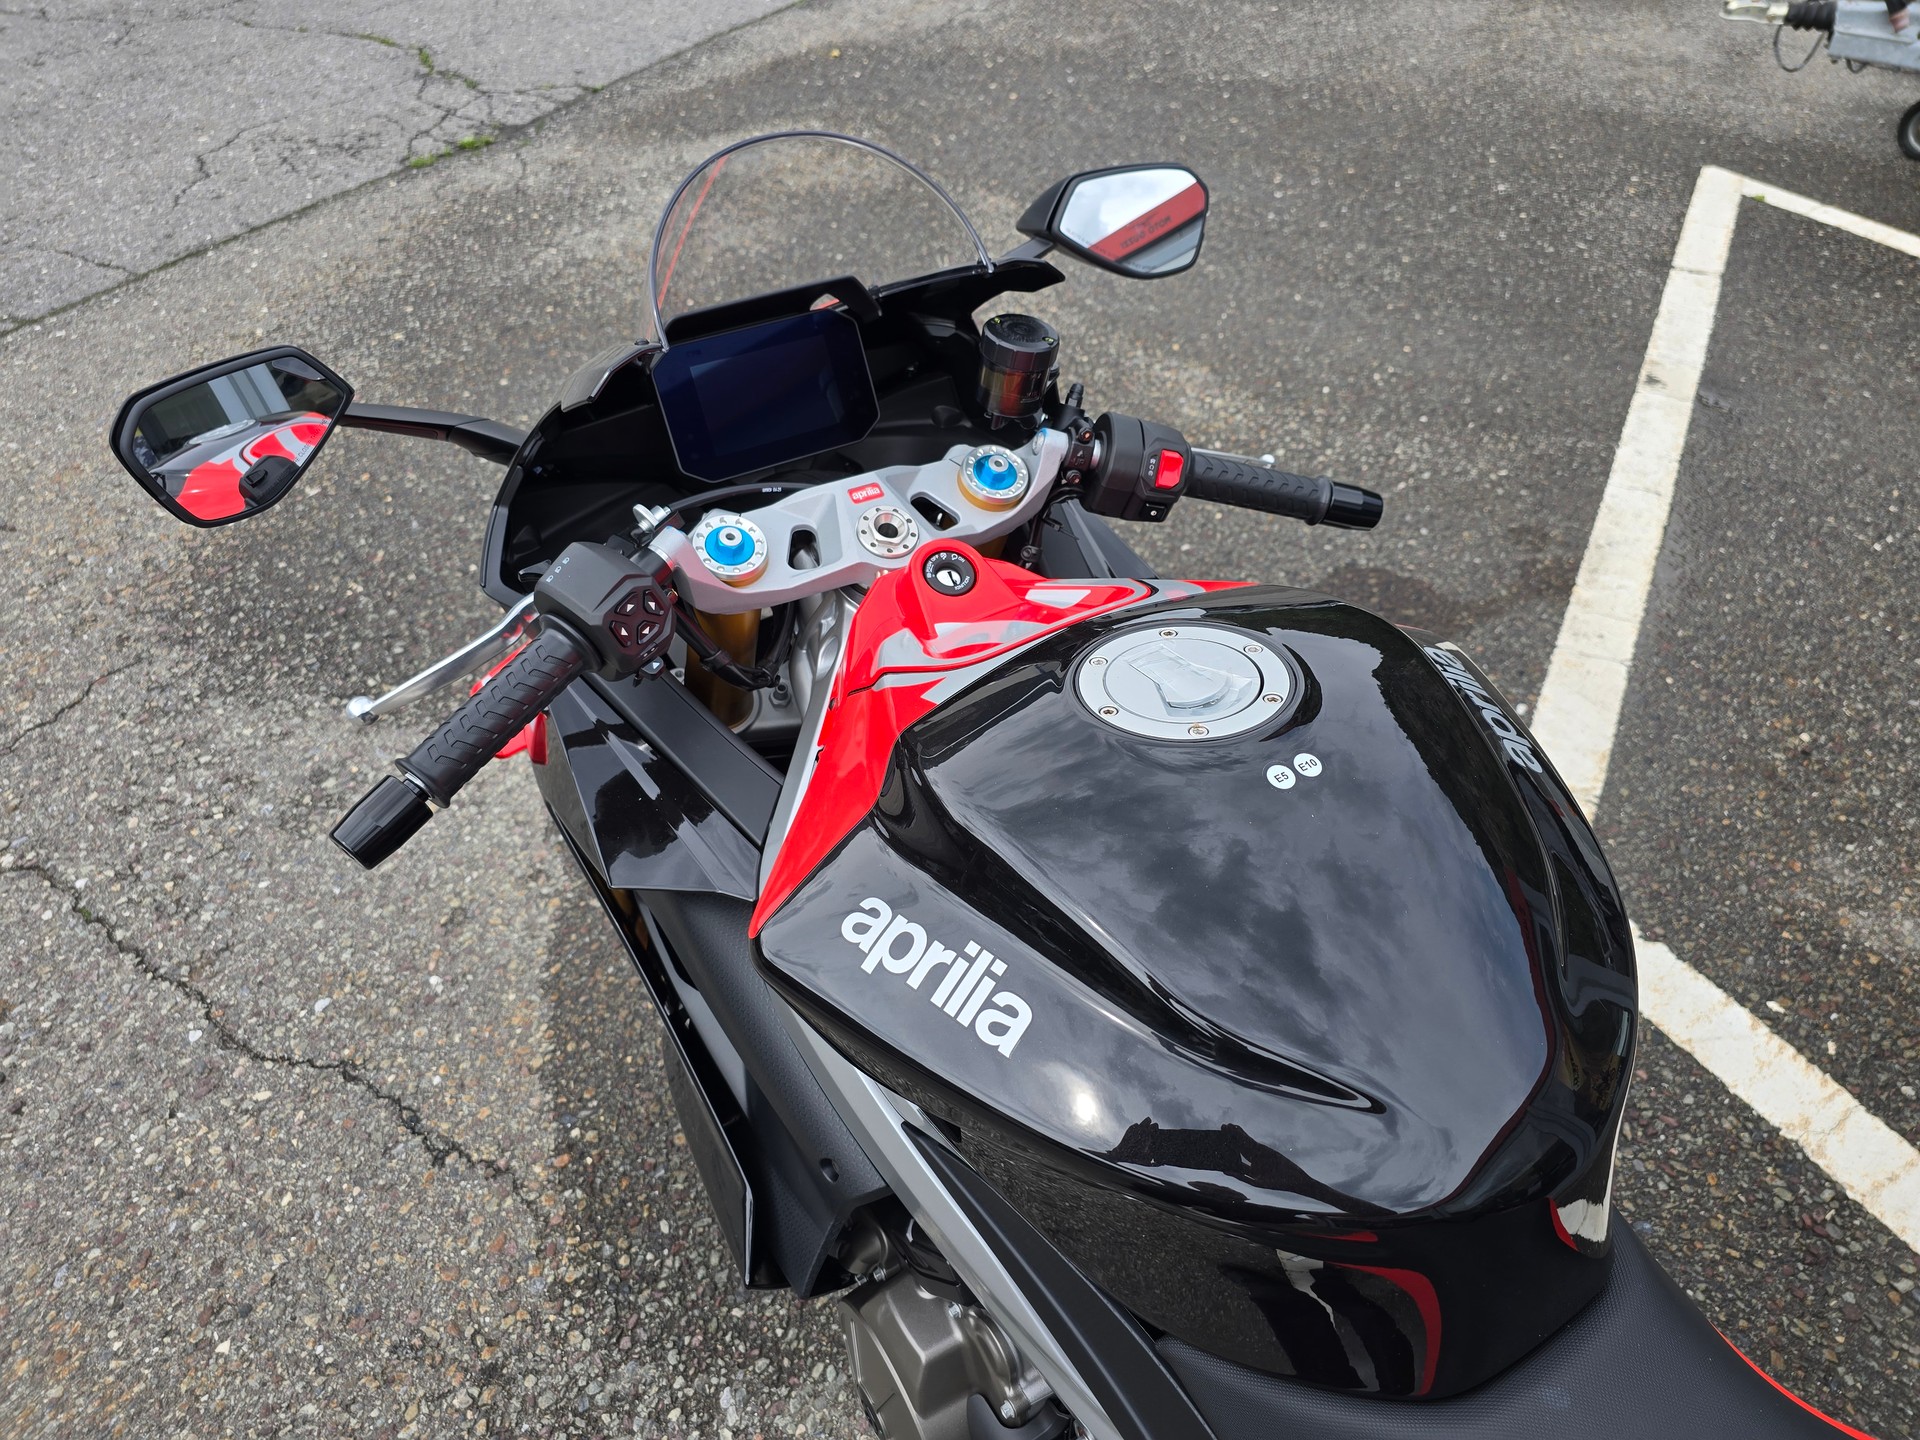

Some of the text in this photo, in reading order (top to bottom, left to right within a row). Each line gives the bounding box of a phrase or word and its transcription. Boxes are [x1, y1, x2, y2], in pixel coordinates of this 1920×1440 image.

[851, 486, 881, 500] aprilia
[1423, 646, 1543, 774] aprilia
[1297, 758, 1318, 772] E10
[1273, 771, 1289, 783] E5
[841, 897, 1033, 1059] aprilia
